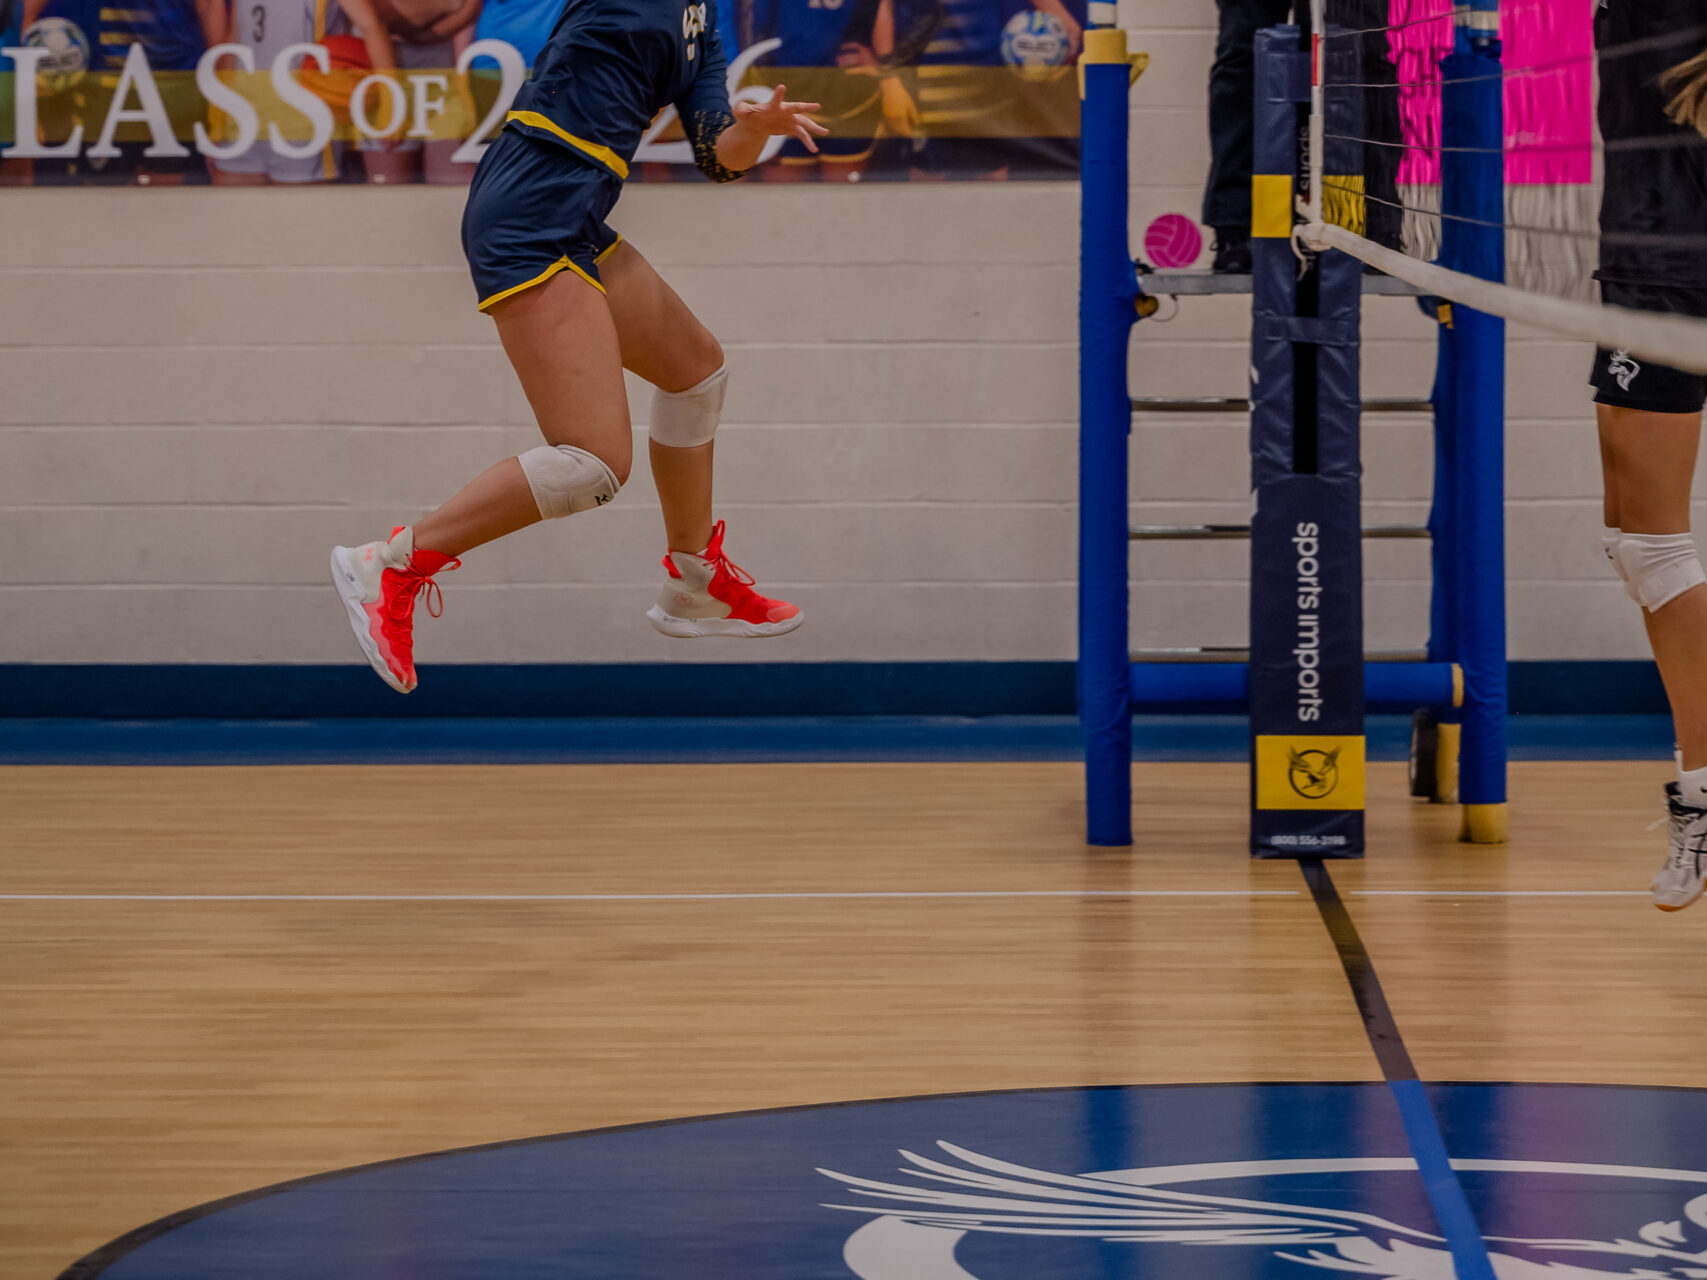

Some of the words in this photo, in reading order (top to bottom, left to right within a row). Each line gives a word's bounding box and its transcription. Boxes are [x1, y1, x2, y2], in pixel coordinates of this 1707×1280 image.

[251, 5, 267, 43] 3
[0, 41, 334, 160] LASS
[350, 74, 448, 139] OF
[1291, 522, 1323, 610] sports
[1292, 614, 1323, 722] imports
